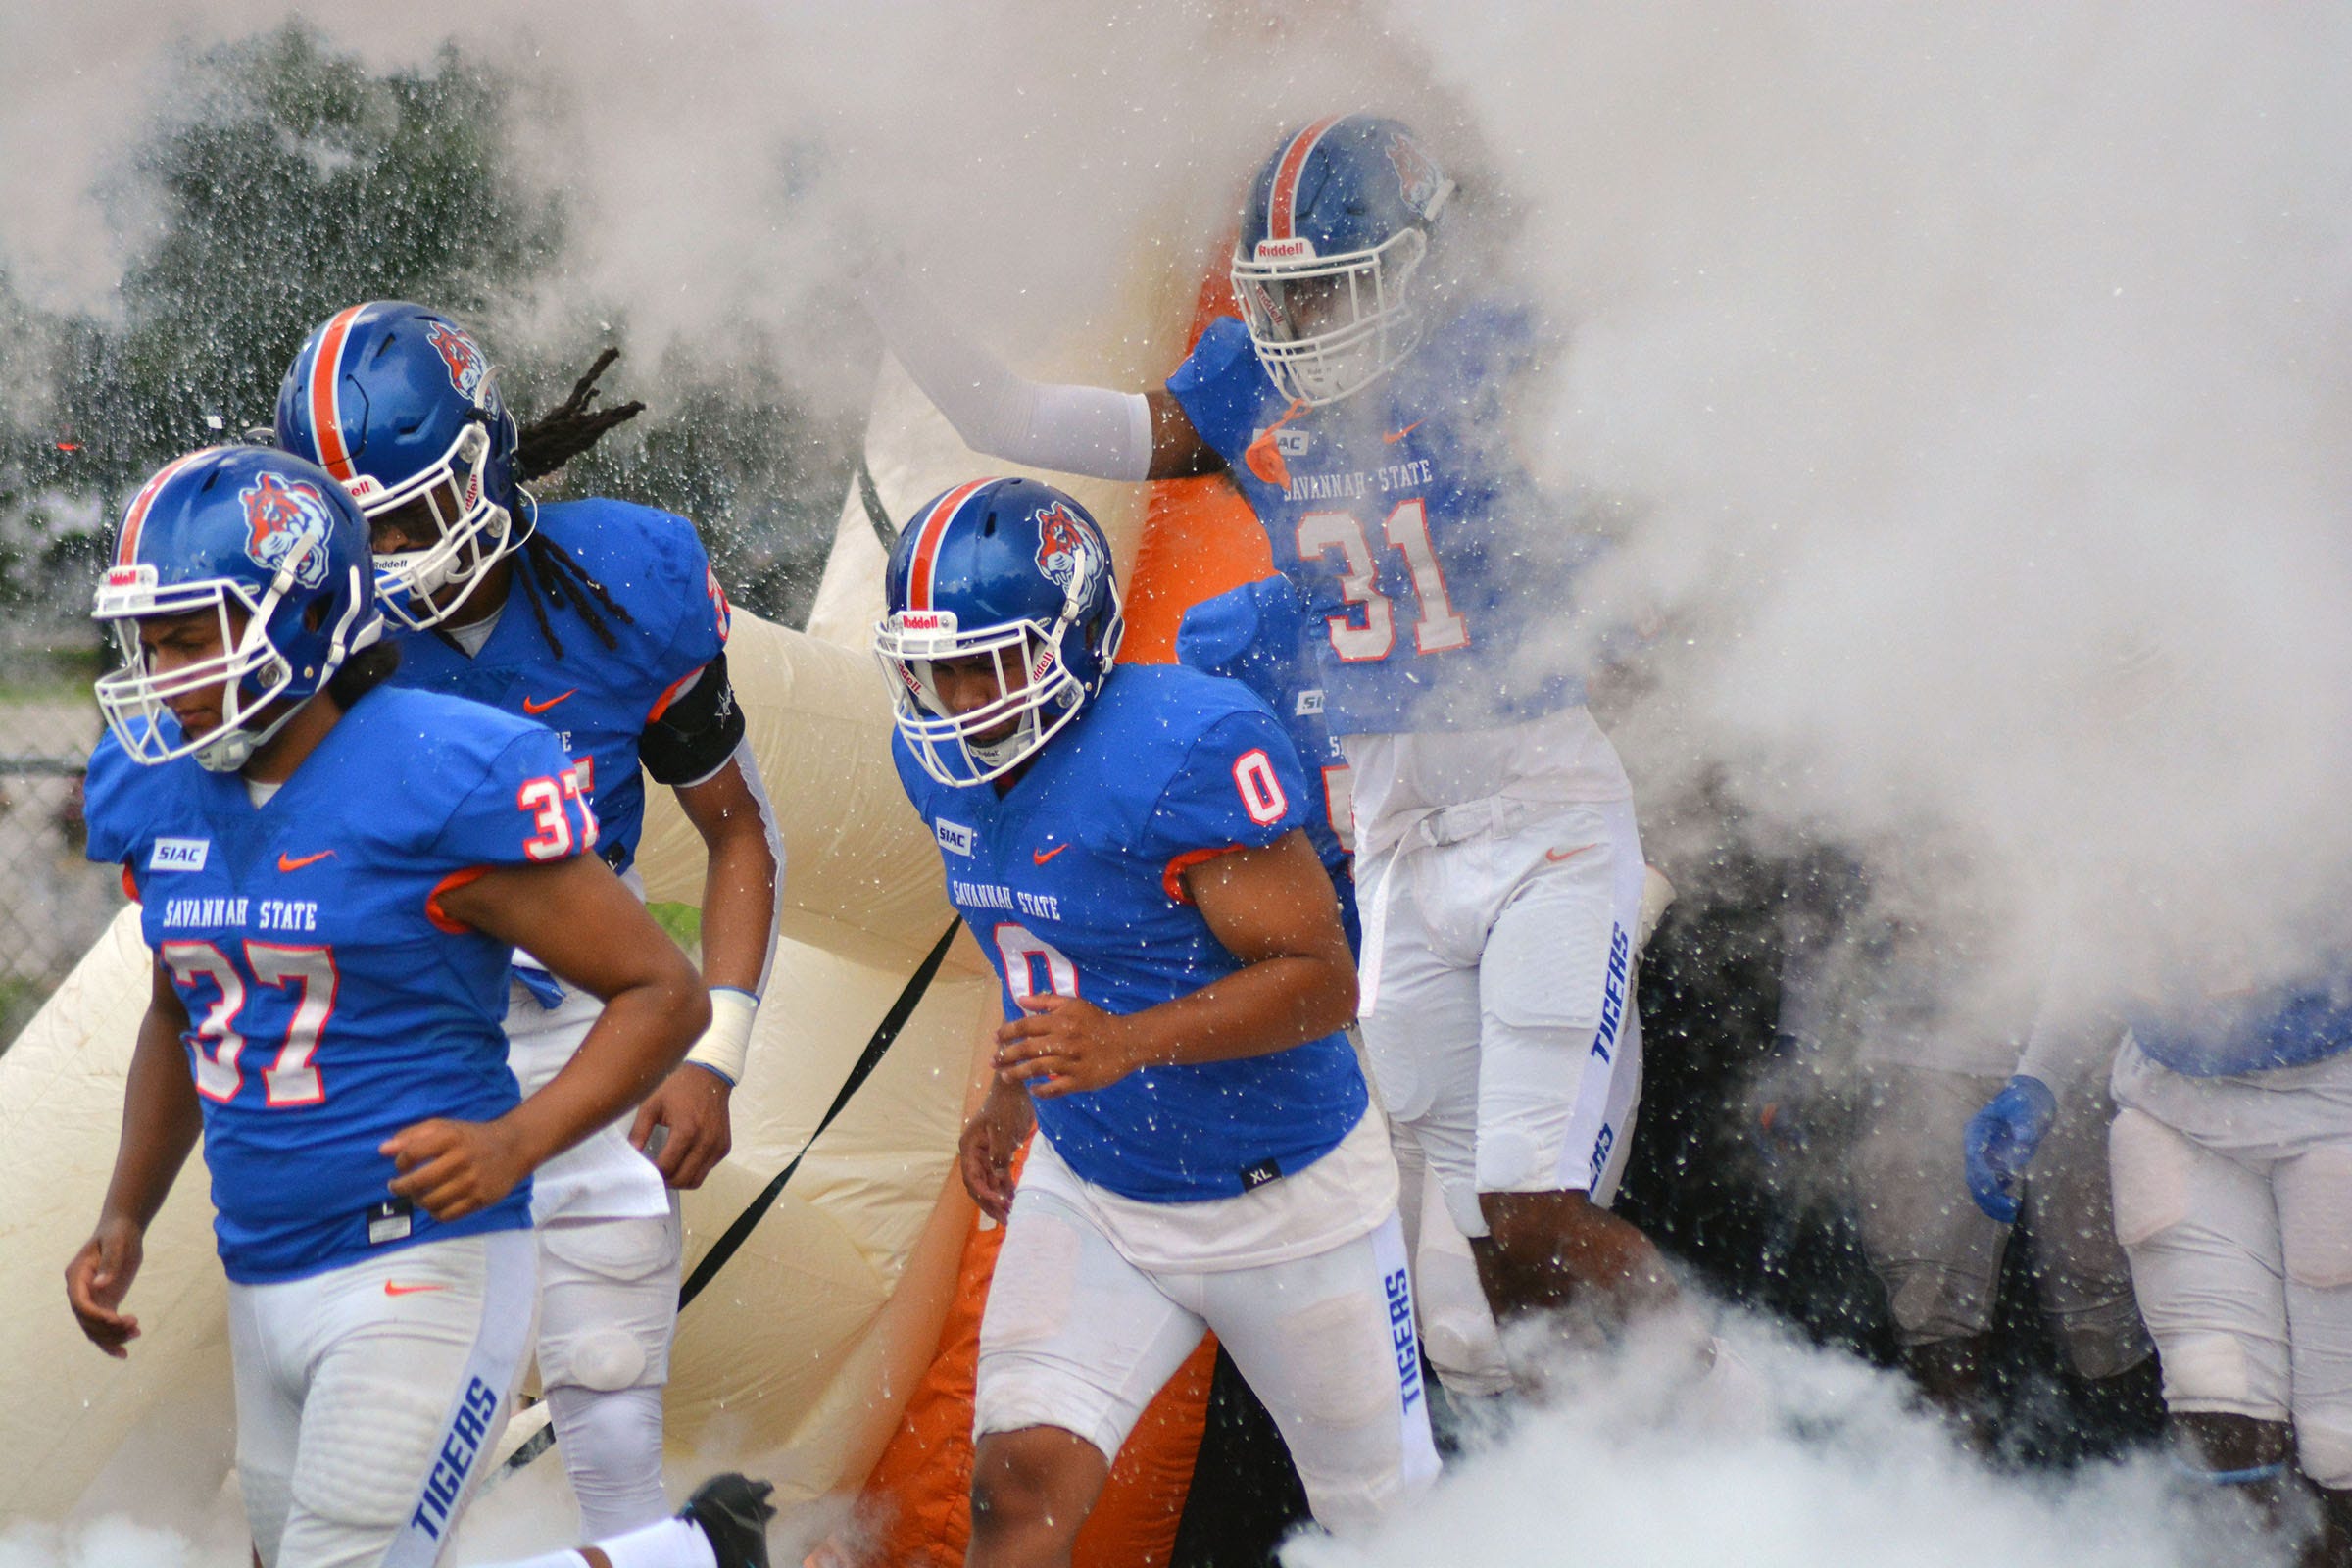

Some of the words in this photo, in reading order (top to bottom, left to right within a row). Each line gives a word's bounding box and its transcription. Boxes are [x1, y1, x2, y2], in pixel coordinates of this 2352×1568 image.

[1258, 242, 1304, 258] Riddell
[1277, 436, 1301, 450] AC
[1378, 459, 1433, 491] STATE
[1295, 497, 1471, 662] 31
[903, 615, 939, 629] Riddell
[1231, 747, 1289, 826] 0
[157, 846, 201, 862] SIAC
[939, 827, 965, 849] SIAC
[163, 898, 249, 928] SAVANNAH
[259, 901, 318, 931] STATE
[953, 879, 1014, 910] SAVANNAH
[1017, 891, 1061, 921] STATE
[1591, 921, 1629, 1065] TIGERS
[161, 938, 340, 1108] 37
[1249, 1168, 1273, 1184] XL
[382, 1202, 395, 1216] L
[1384, 1267, 1421, 1416] TIGERS
[411, 1375, 498, 1542] TIGERS
